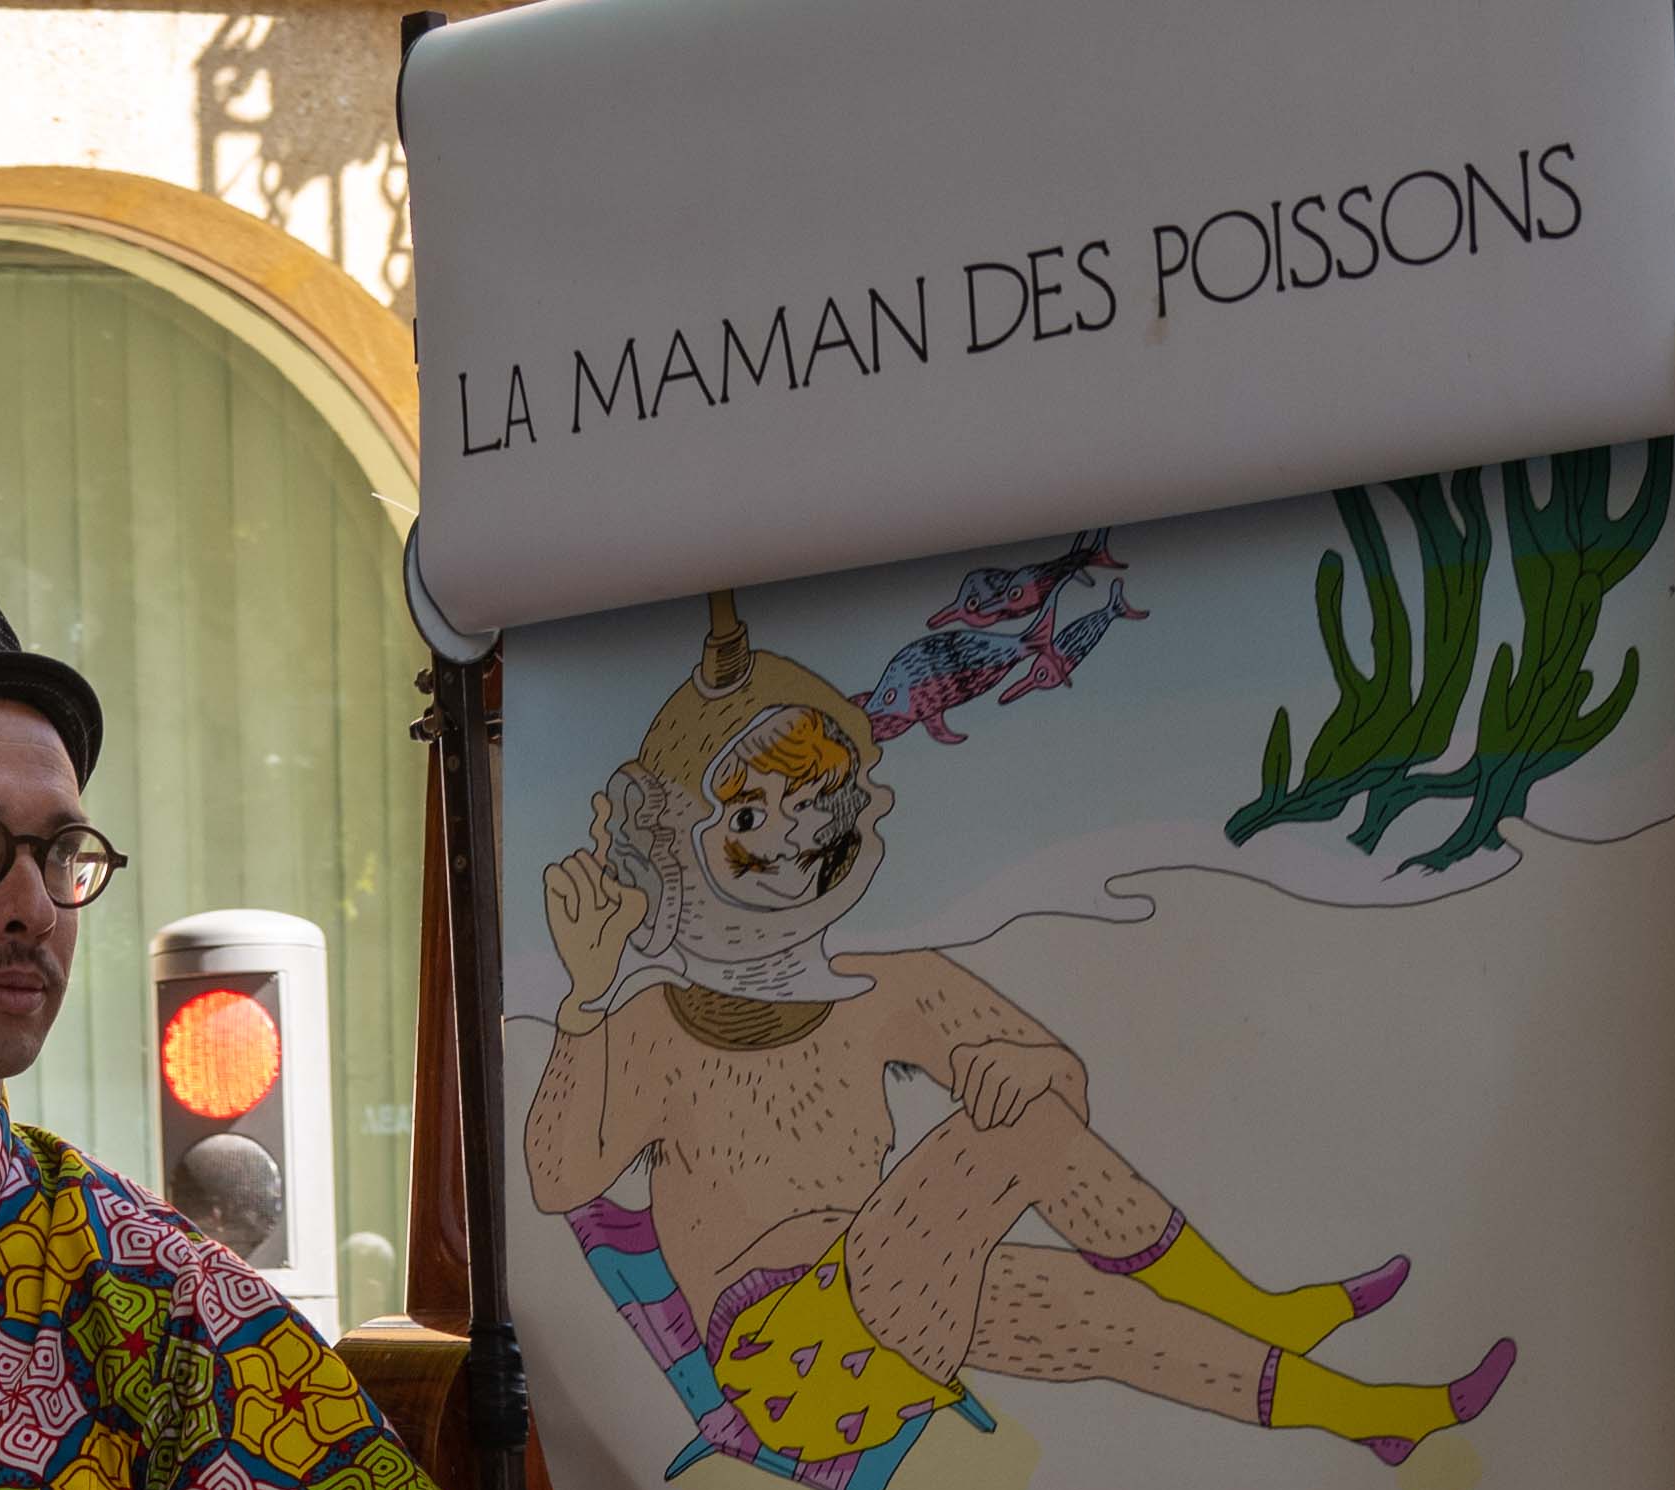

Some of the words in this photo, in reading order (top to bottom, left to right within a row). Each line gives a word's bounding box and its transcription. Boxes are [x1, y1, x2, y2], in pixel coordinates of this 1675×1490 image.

[459, 364, 537, 457] LA
[571, 276, 928, 434] MAMAN
[963, 238, 1117, 354] DES
[1152, 142, 1583, 318] POISSONS
